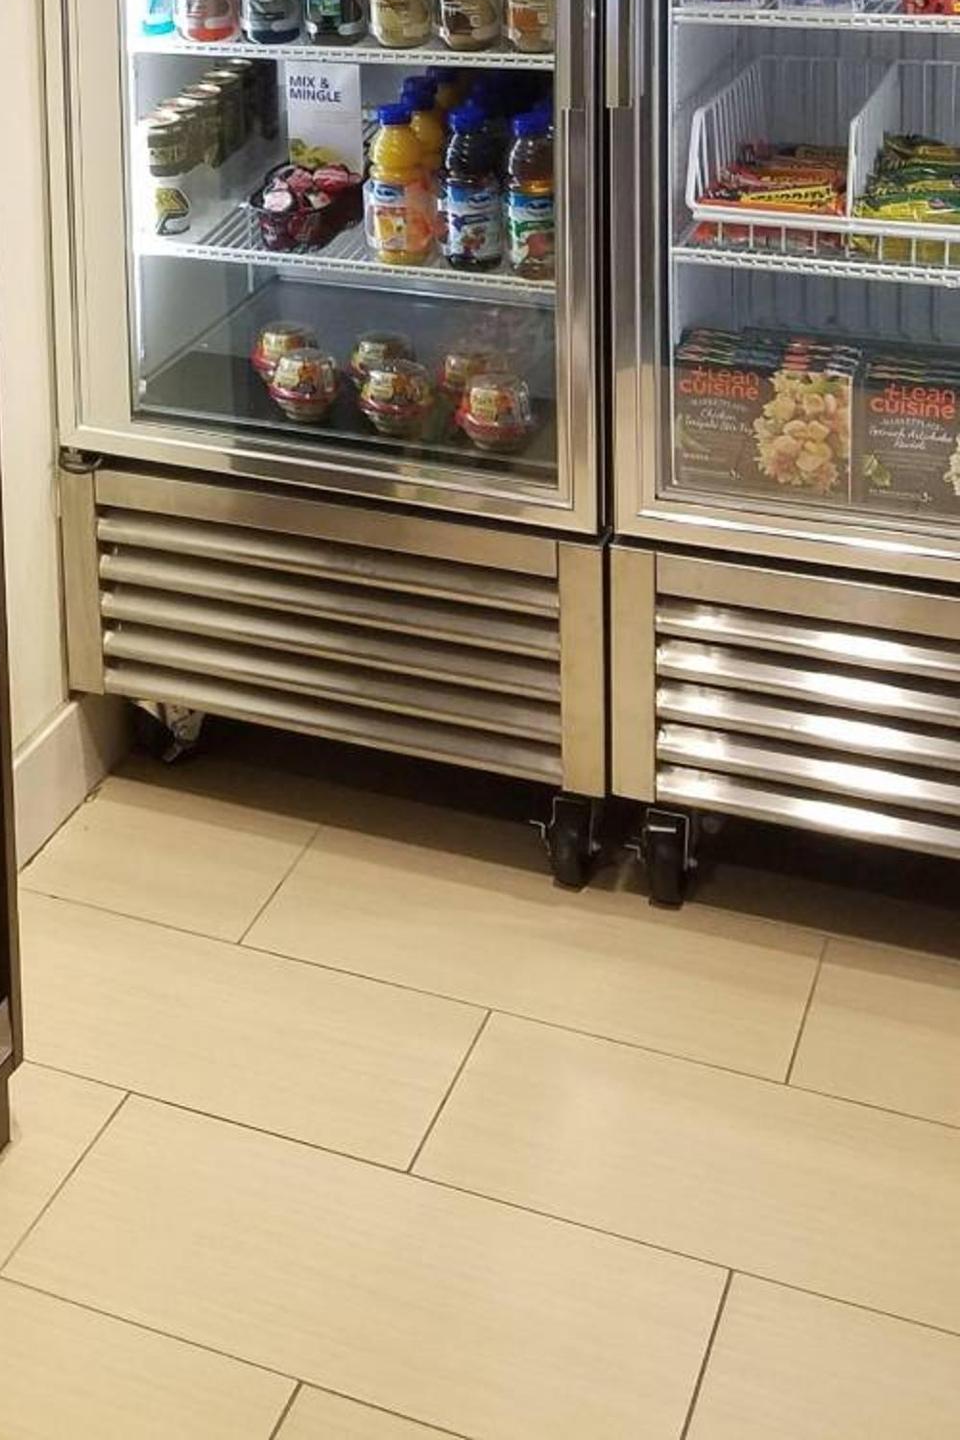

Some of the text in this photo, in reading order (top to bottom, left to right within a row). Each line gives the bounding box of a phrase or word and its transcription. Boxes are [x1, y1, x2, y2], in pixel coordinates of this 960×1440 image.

[289, 76, 329, 89] MIX &
[289, 88, 341, 102] MINGLE
[679, 379, 760, 401] cuisine
[870, 396, 956, 421] cuisine
